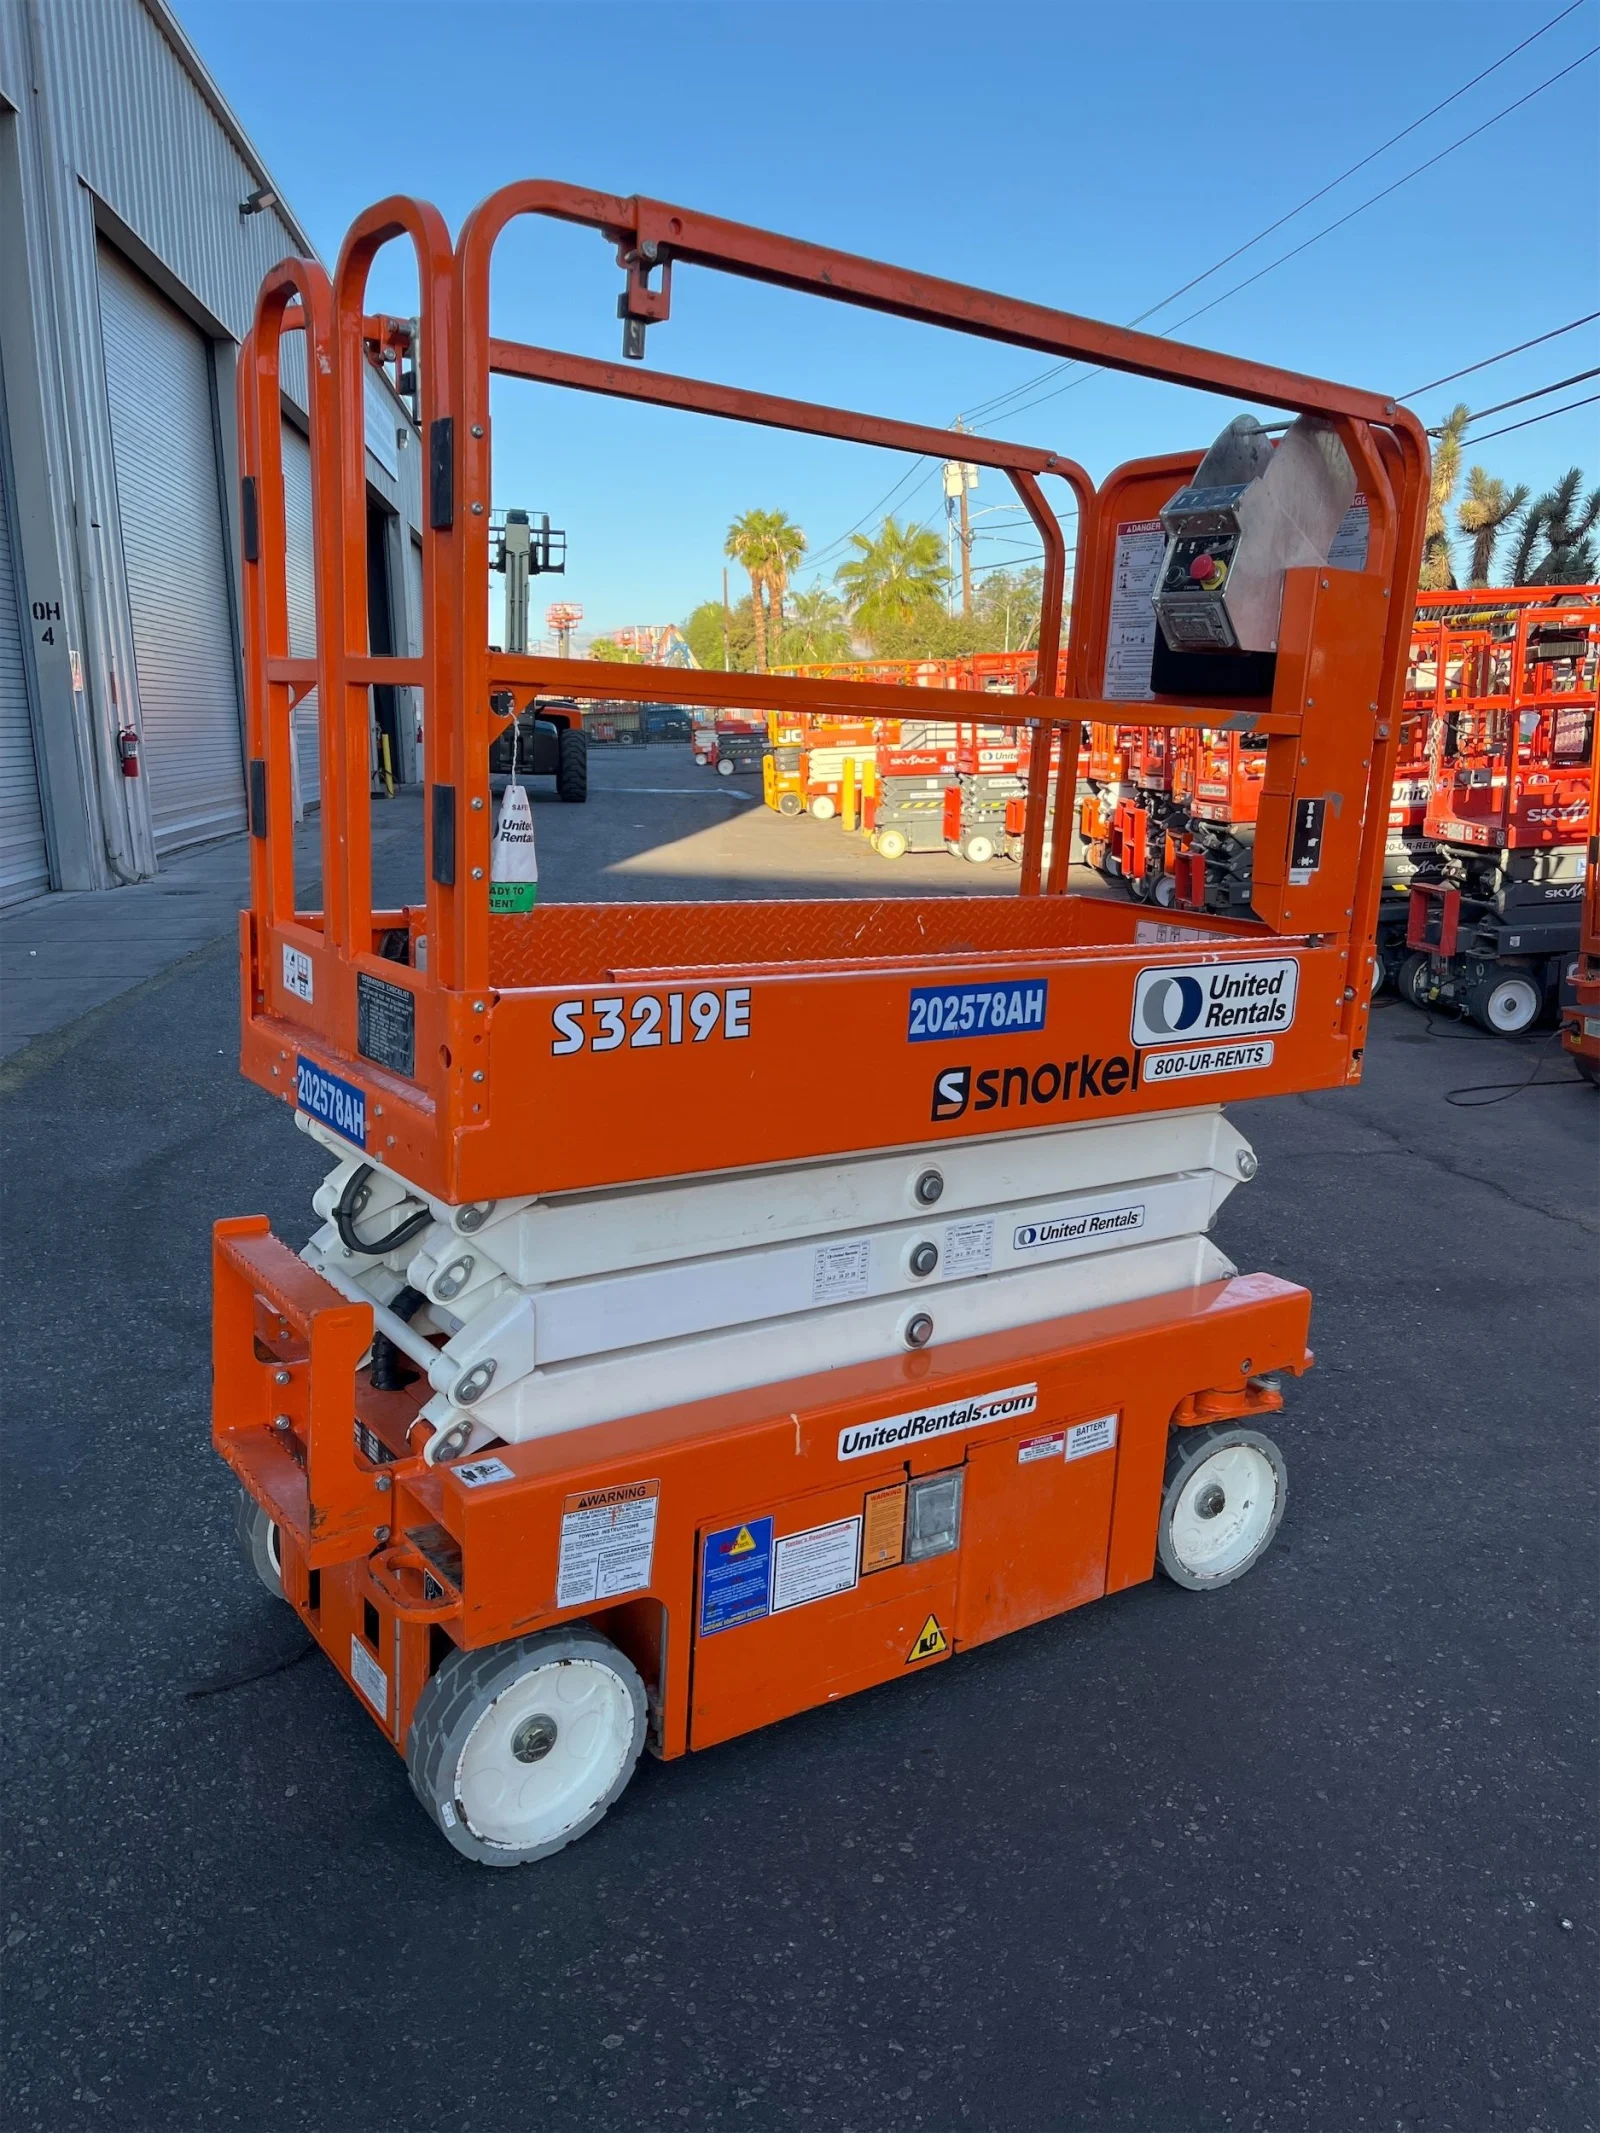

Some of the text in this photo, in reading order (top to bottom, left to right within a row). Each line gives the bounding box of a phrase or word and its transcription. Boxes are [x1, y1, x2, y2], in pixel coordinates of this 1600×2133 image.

[1131, 522, 1161, 533] DANGER
[32, 601, 61, 621] OH
[41, 626, 55, 646] 4
[778, 729, 802, 744] JC
[890, 754, 938, 766] SKYJACK
[995, 749, 1018, 760] Unite
[489, 887, 525, 896] ADY TO
[1209, 969, 1286, 1000] United
[909, 988, 1044, 1035] 202578AH
[1204, 997, 1287, 1028] Rentals
[552, 987, 752, 1057] S3219E
[1154, 1046, 1265, 1076] 800-UR-RENTS
[973, 1049, 1142, 1111] snorkel
[297, 1064, 364, 1140] 202578AH
[1040, 1210, 1139, 1241] United Rentals
[842, 1394, 1036, 1454] UnitedRentals.com
[1076, 1420, 1108, 1437] BATTERY
[586, 1486, 646, 1507] WARNING
[870, 1488, 902, 1501] WARNING
[578, 1531, 600, 1540] TOWING
